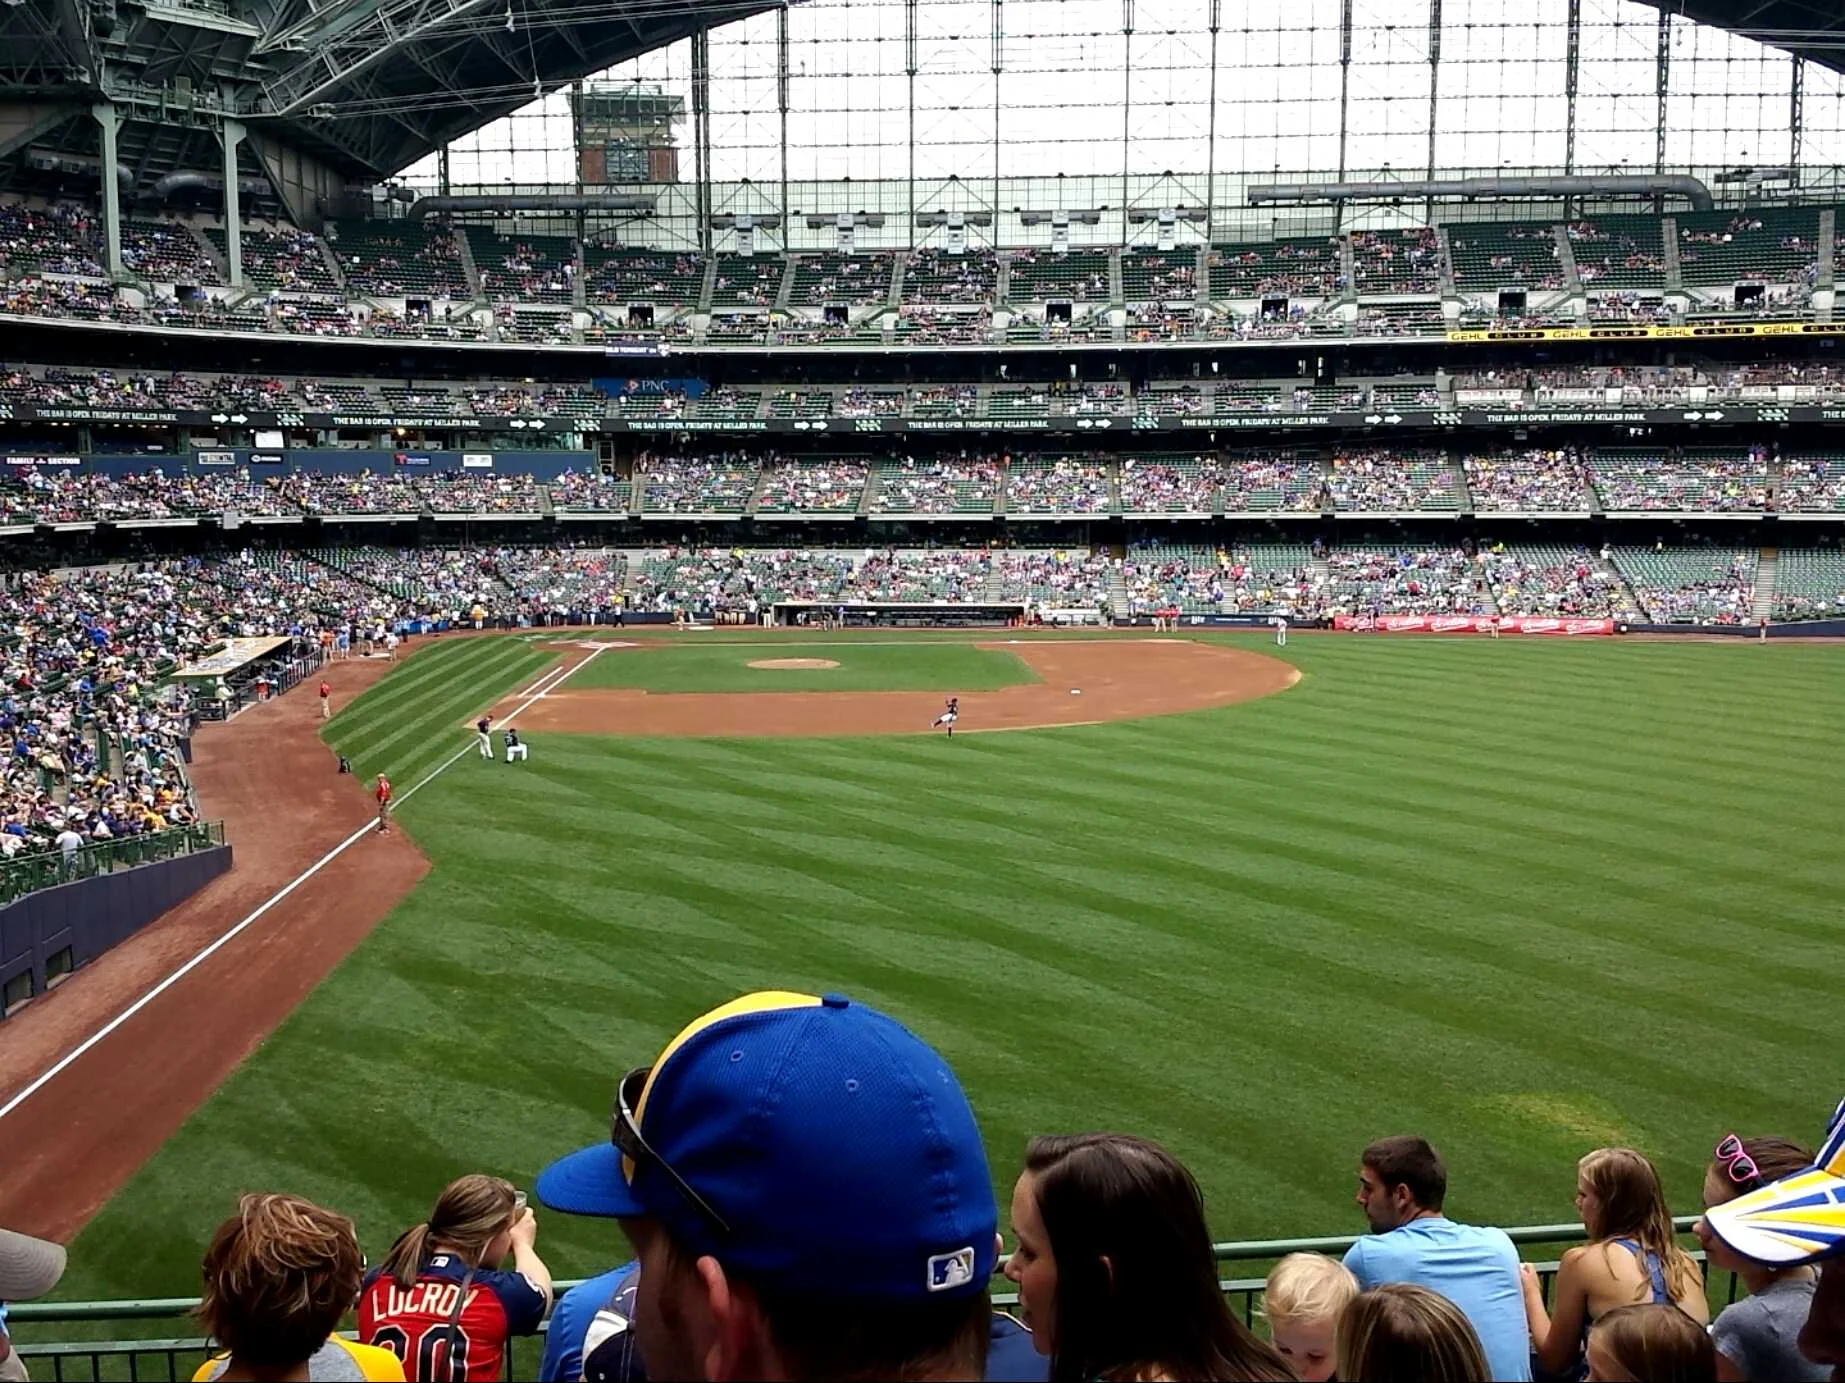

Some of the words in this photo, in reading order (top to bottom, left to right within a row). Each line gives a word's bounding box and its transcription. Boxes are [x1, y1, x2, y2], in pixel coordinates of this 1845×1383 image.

[1656, 328, 1690, 337] GEHL
[1762, 325, 1800, 334] GEHL
[1451, 333, 1485, 341] GEHL
[1552, 330, 1587, 338] GEHL
[641, 379, 670, 391] PNC
[121, 412, 131, 420] AT
[132, 412, 158, 420] MILLER
[1004, 420, 1029, 428] MILLER
[1181, 419, 1197, 427] THE
[372, 1283, 479, 1322] LUCROY
